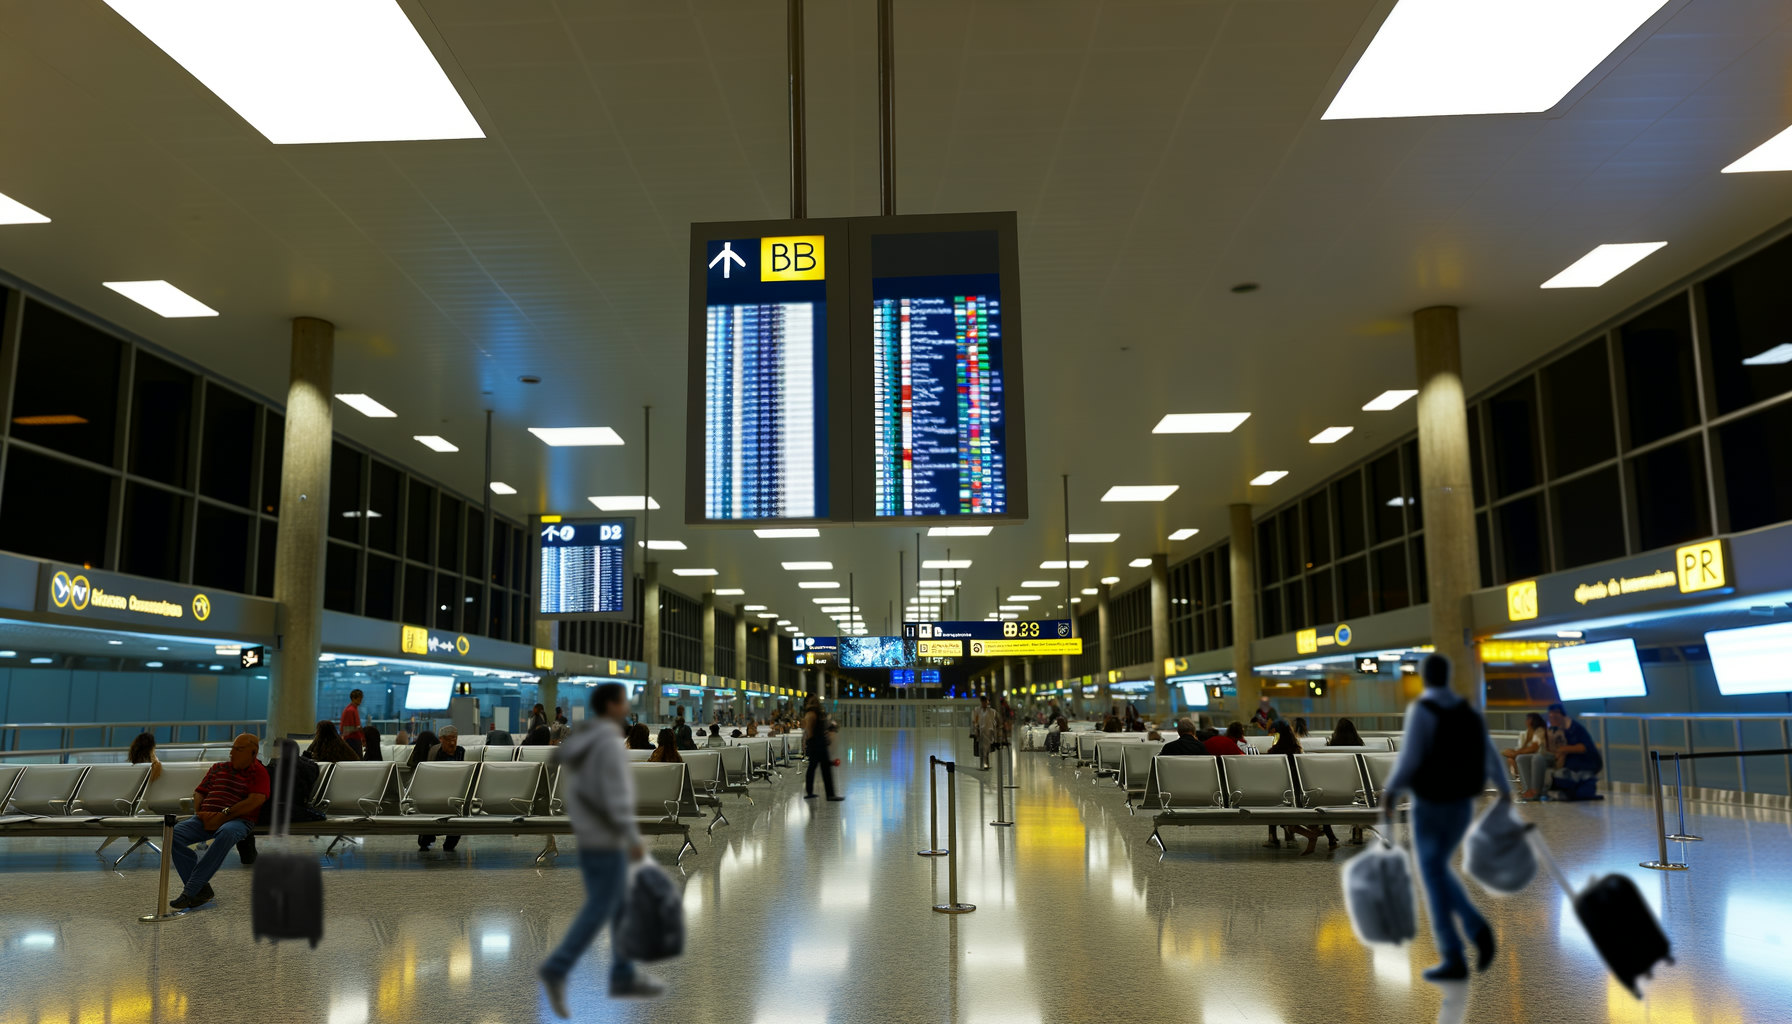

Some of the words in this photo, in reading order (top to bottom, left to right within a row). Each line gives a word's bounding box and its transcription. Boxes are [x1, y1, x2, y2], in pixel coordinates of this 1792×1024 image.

[772, 242, 816, 272] BB
[600, 525, 622, 541] D2
[1685, 549, 1717, 585] PR
